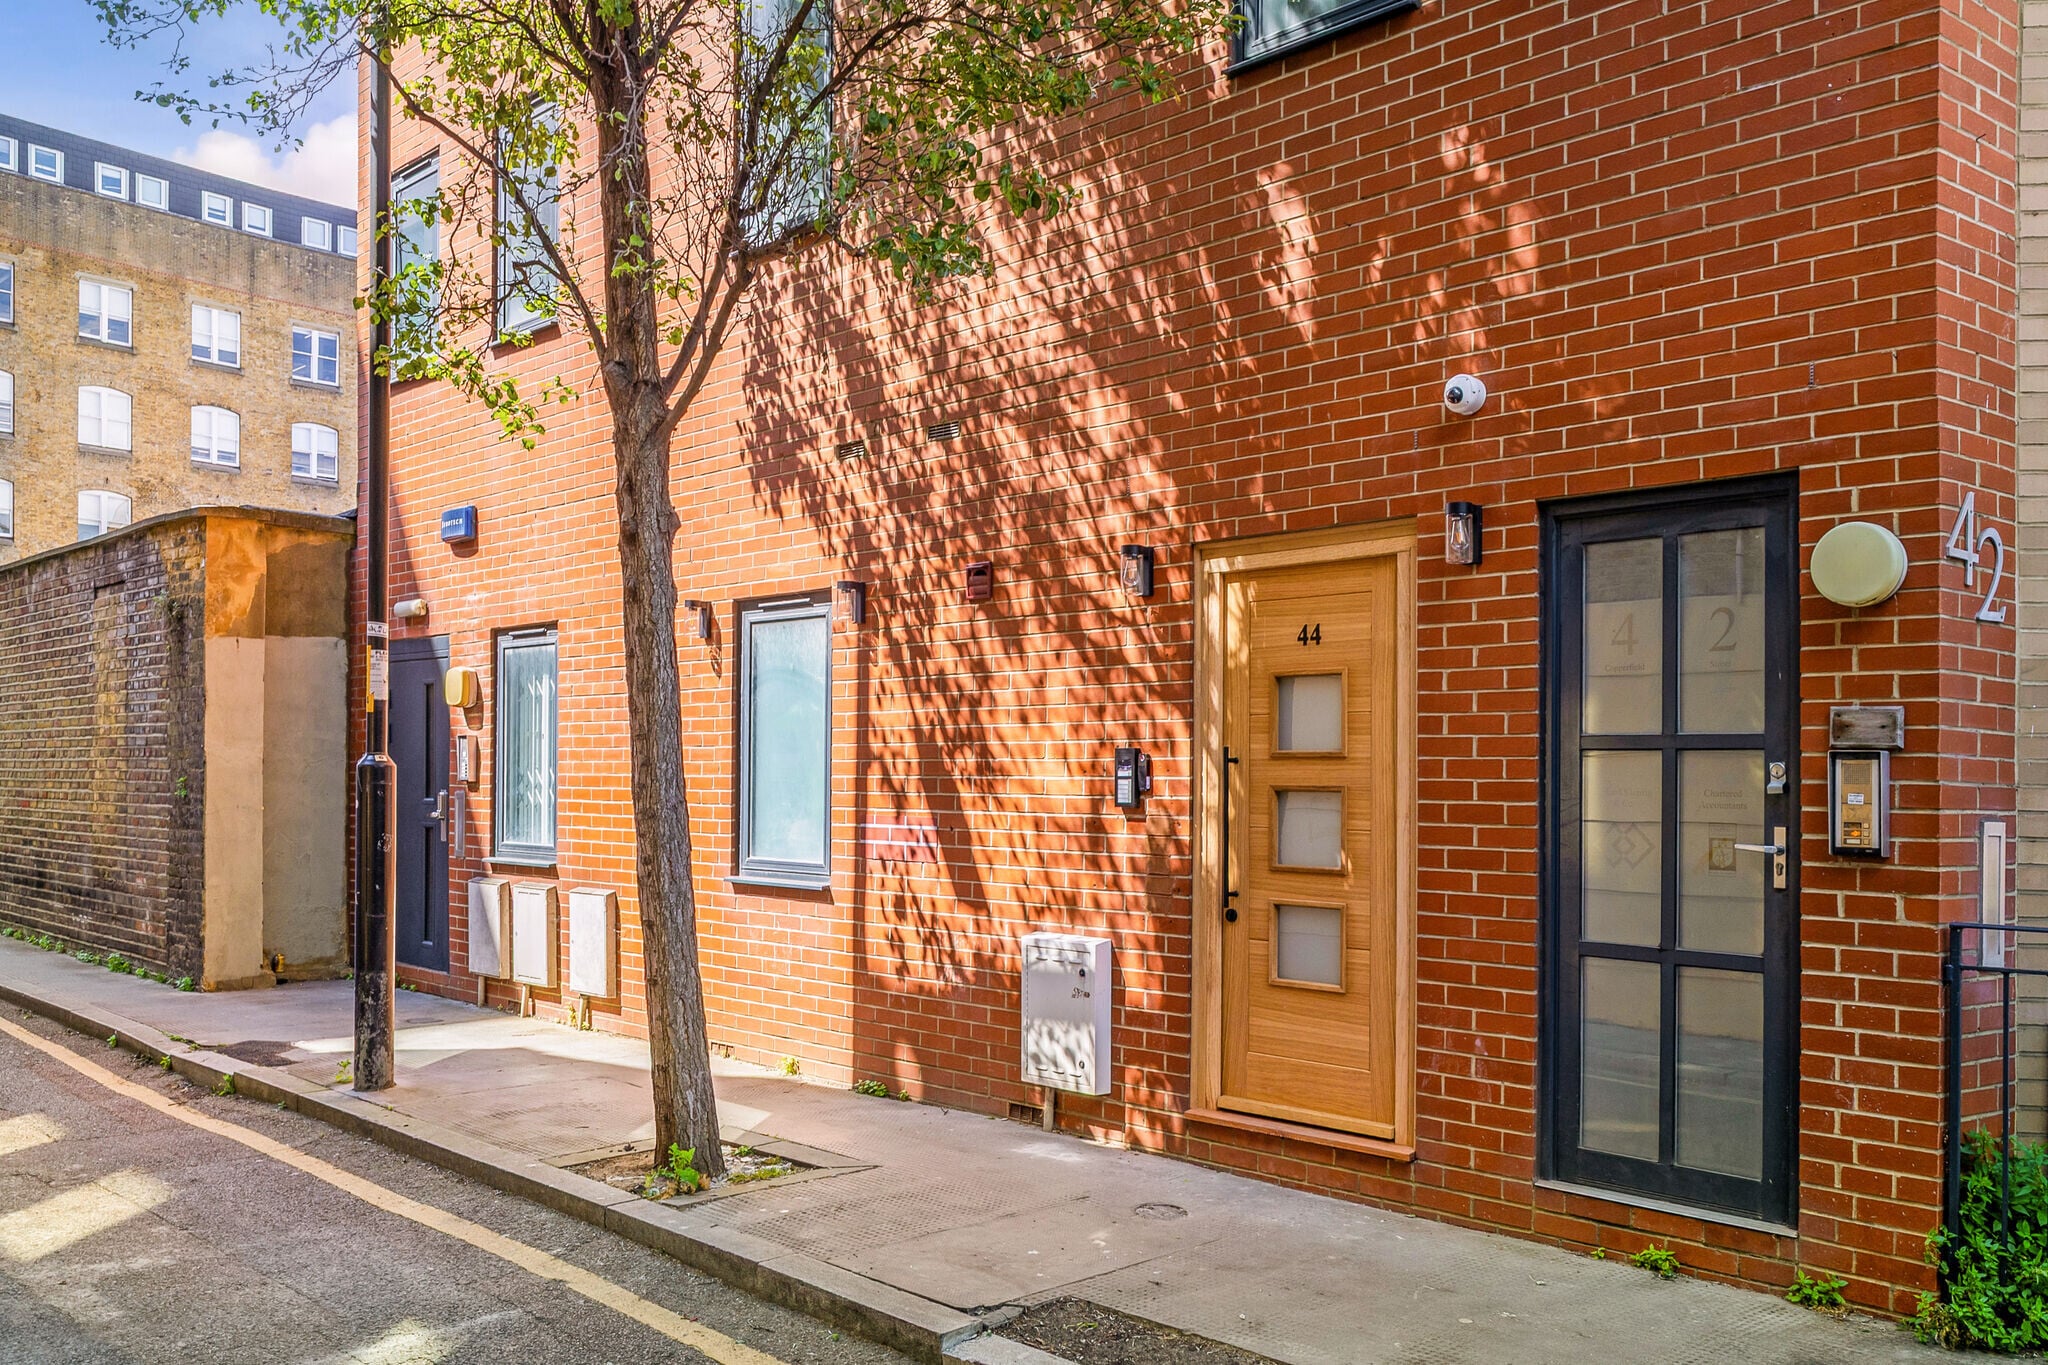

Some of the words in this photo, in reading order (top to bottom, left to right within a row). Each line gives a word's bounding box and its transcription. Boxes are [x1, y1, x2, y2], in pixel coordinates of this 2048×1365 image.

[1945, 491, 2006, 622] 42
[1297, 623, 1321, 647] 44
[1703, 788, 1744, 798] Chartered
[1698, 800, 1748, 810] Accountants
